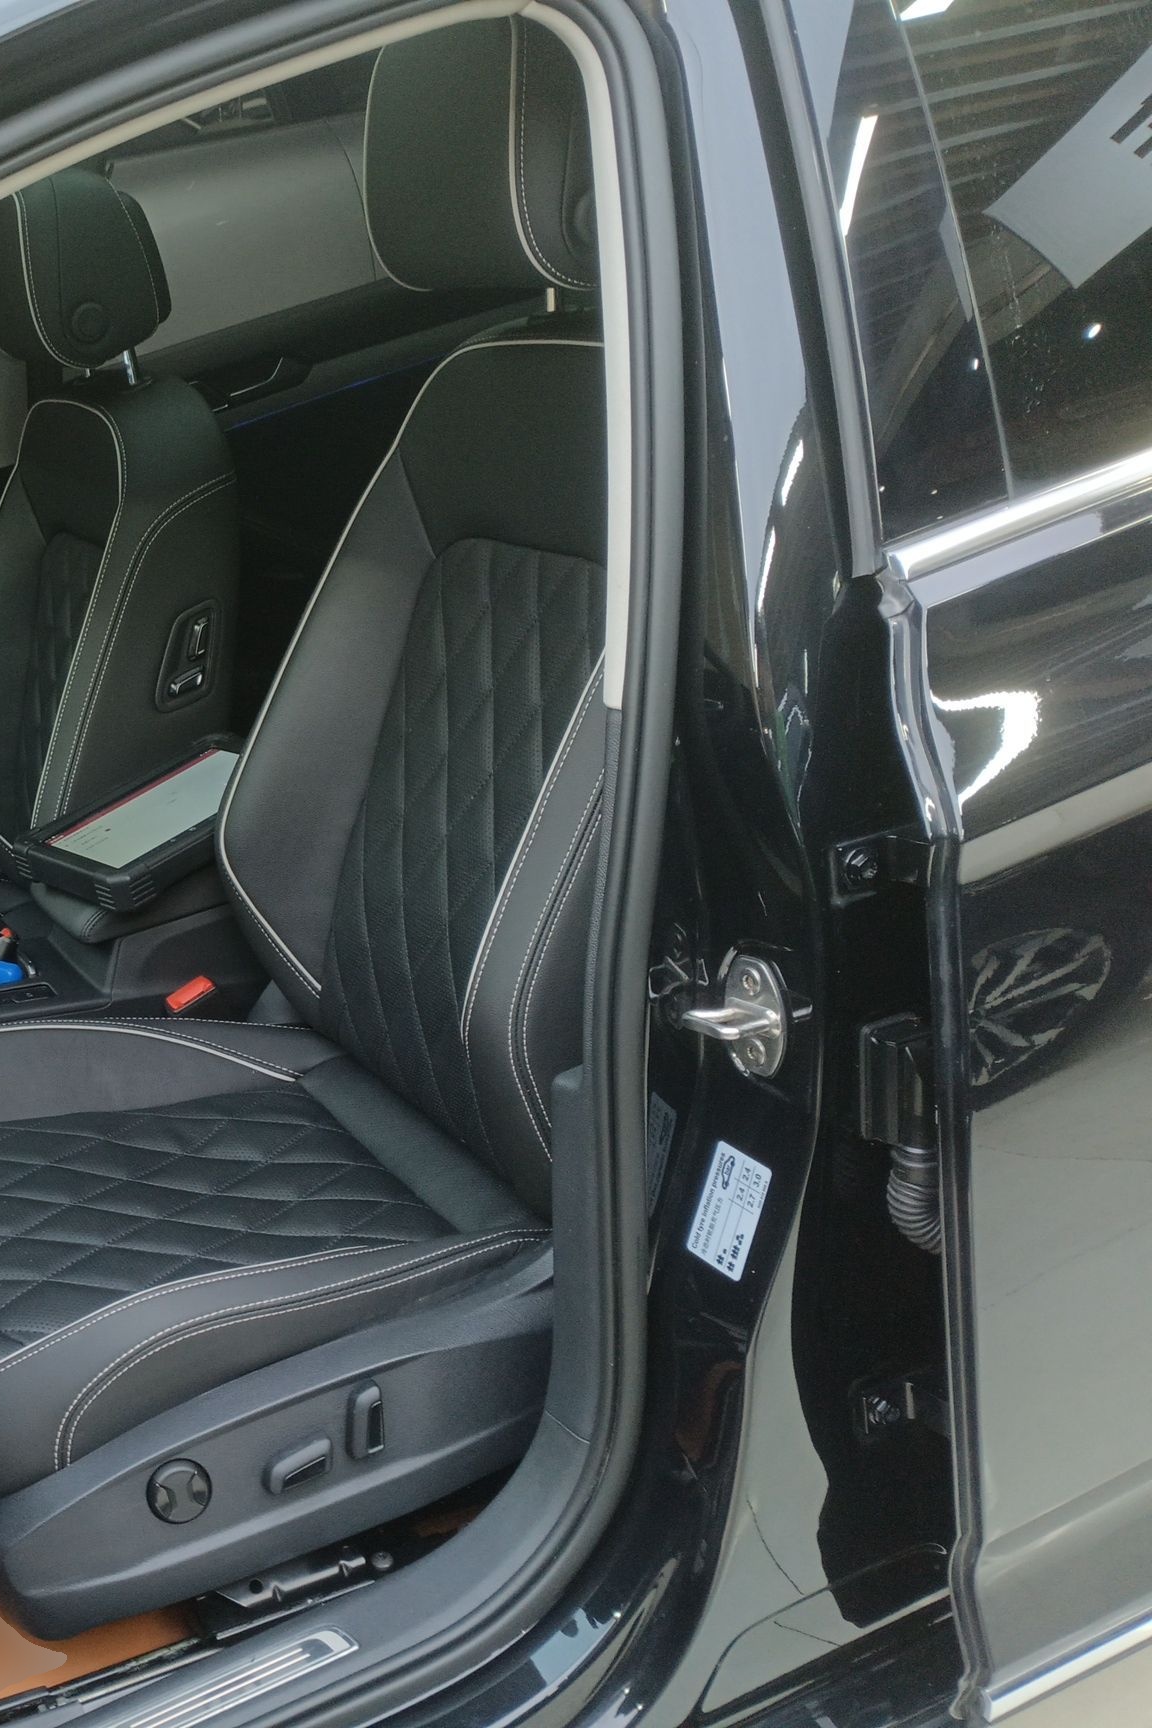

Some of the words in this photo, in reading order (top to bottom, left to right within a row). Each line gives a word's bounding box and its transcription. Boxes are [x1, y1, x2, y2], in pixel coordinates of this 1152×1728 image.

[711, 1152, 726, 1188] pressures
[736, 1187, 745, 1201] 2.4
[742, 1167, 751, 1180] 2.4
[701, 1187, 714, 1217] inflation
[747, 1193, 756, 1208] 2.7
[753, 1173, 762, 1188] 3.0
[691, 1231, 701, 1249] Cold
[697, 1216, 706, 1232] tyre
